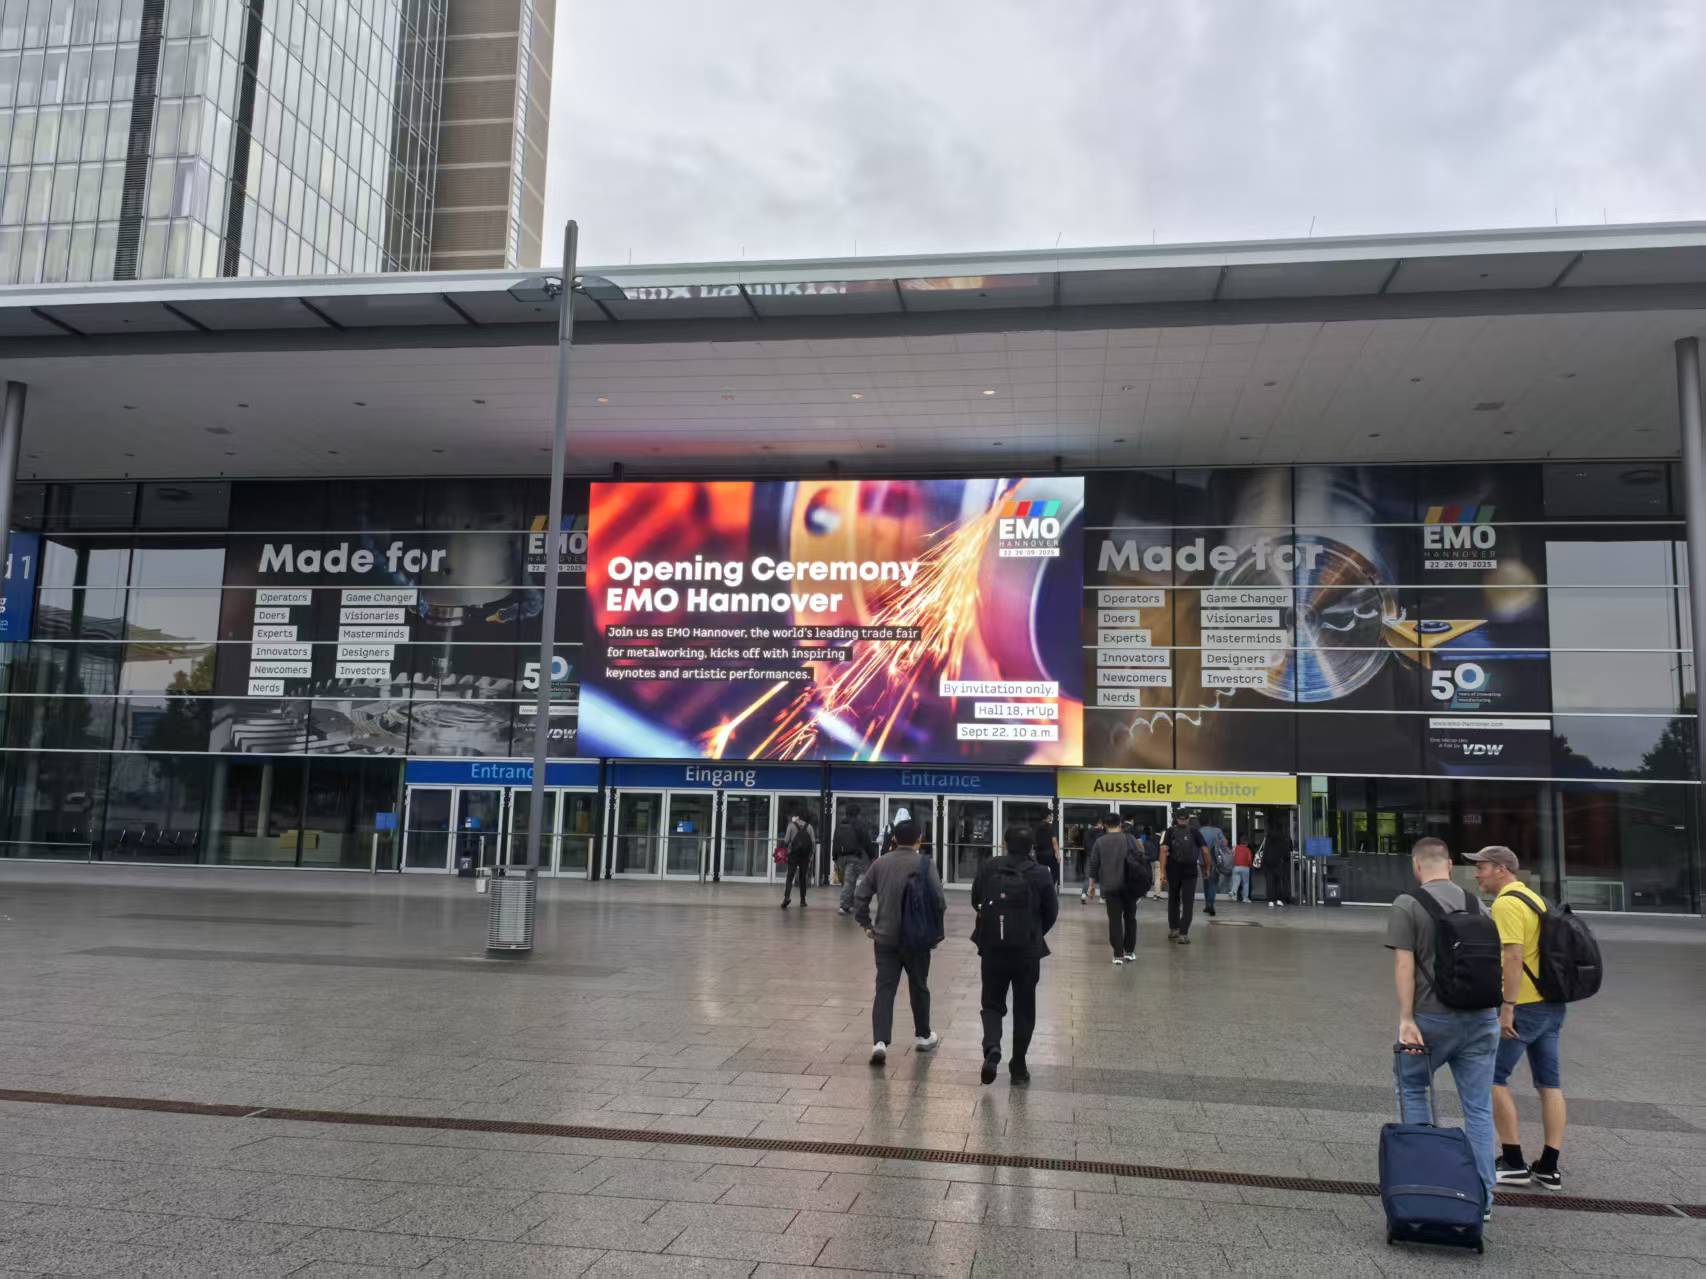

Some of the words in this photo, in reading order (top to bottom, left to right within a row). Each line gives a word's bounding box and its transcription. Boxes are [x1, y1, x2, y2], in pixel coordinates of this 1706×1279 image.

[1000, 517, 1060, 540] EMO
[1424, 525, 1497, 549] EMO
[999, 540, 1059, 548] HANNOVER
[258, 542, 375, 574] Made
[385, 541, 447, 573] for
[1097, 537, 1238, 572] Made
[1251, 536, 1324, 571] for
[21, 555, 31, 579] 1
[607, 554, 744, 588] Opening
[751, 555, 921, 588] Ceremony
[260, 593, 308, 603] Operators
[345, 593, 371, 602] Game
[373, 593, 414, 604] Changer
[606, 587, 680, 613] EMO
[686, 587, 844, 613] Hannover
[1103, 594, 1160, 604] Operators
[1205, 594, 1238, 603] Game
[1240, 594, 1289, 605] Changer
[259, 611, 286, 620] Doers
[344, 611, 400, 621] Visionaries
[1103, 613, 1136, 623] Doers
[1205, 613, 1273, 623] Visionaries
[257, 630, 294, 640] Experts
[343, 629, 405, 639] Masterminds
[607, 627, 633, 638] Join
[636, 629, 648, 638] us
[651, 629, 664, 638] as
[666, 628, 690, 638] EMO
[750, 627, 770, 639] the
[772, 627, 813, 639] world's
[815, 627, 859, 641] leading
[861, 628, 893, 639] trade
[895, 628, 919, 639] fair
[1103, 633, 1147, 644] Experts
[1206, 633, 1282, 644] Masterminds
[255, 647, 308, 656] Innovators
[341, 648, 390, 659] Designers
[607, 646, 625, 658] for
[711, 647, 740, 659] kicks
[742, 647, 761, 659] off
[763, 647, 789, 659] with
[792, 647, 846, 661] inspiring
[1102, 653, 1165, 663] Innovators
[1206, 654, 1265, 665] Designers
[254, 665, 308, 675] Newcomers
[339, 666, 387, 676] Investors
[605, 666, 657, 680] keynotes
[658, 667, 680, 679] and
[682, 667, 727, 679] artistic
[729, 668, 812, 681] performances.
[1102, 672, 1168, 683] Newcomers
[1206, 673, 1264, 684] Investors
[1430, 662, 1486, 700] 50
[252, 683, 281, 693] Nerds
[943, 683, 958, 695] By
[960, 683, 1023, 695] invitation
[1025, 684, 1055, 697] only.
[1102, 691, 1136, 702] Nerds
[978, 705, 1004, 716] Hall
[960, 726, 989, 739] Sept
[1013, 727, 1028, 738] 10
[1029, 729, 1054, 738] a.m.
[1462, 743, 1504, 756] VDW
[471, 763, 535, 779] Entranc
[685, 765, 757, 787] Eingang
[902, 770, 982, 788] Entrance
[1093, 778, 1173, 794] Aussteller
[1184, 781, 1261, 797] Exhibitor
